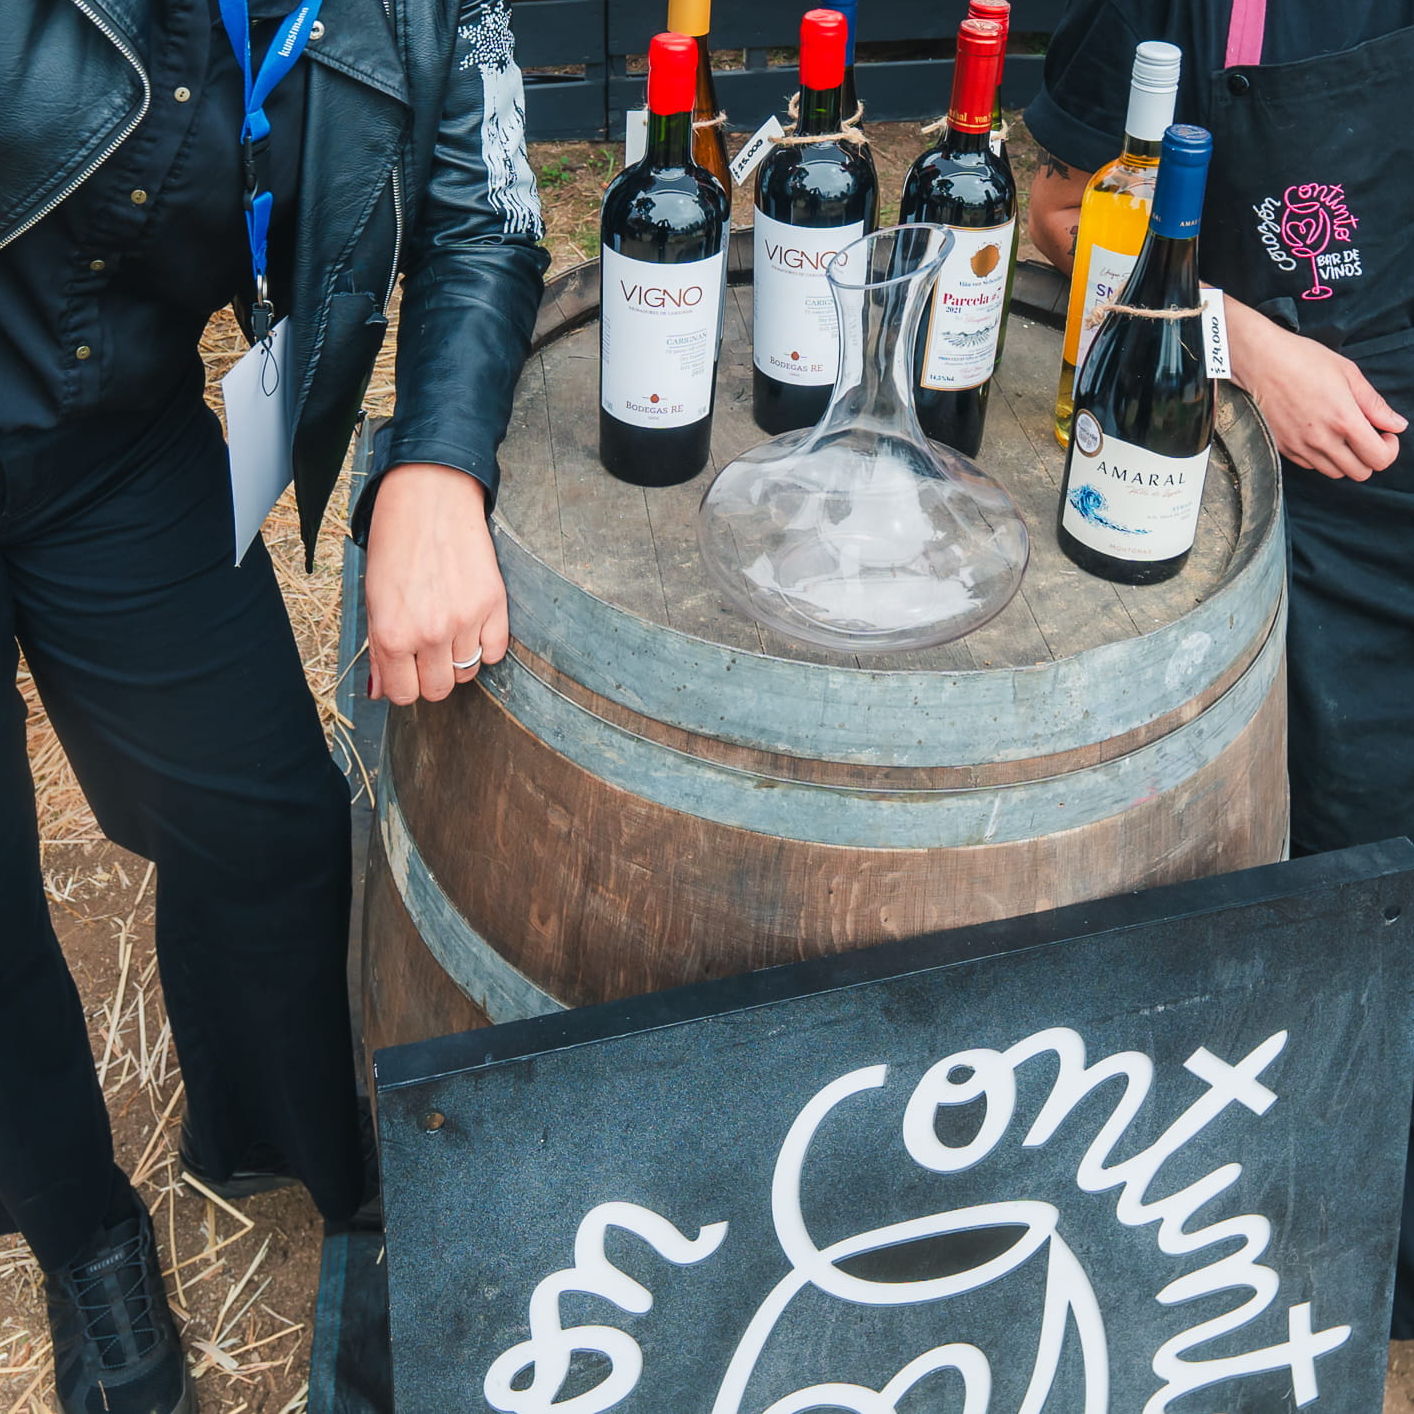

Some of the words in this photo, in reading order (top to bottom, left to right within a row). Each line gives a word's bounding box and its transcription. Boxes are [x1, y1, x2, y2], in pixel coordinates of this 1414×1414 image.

[278, 7, 310, 58] kunstmann
[765, 239, 849, 271] VIGNO
[1316, 252, 1341, 267] BAR
[1343, 248, 1360, 262] DE
[1318, 262, 1363, 280] VINOS
[620, 279, 703, 308] VIGNO
[941, 292, 990, 308] Parcela
[666, 333, 707, 346] CARIGNAN
[770, 355, 808, 373] BODEGAS
[811, 363, 824, 373] RE
[626, 401, 668, 414] BODEGAS
[671, 405, 684, 413] RE
[1096, 460, 1187, 487] AMARAL
[771, 1026, 1352, 1414] Contint
